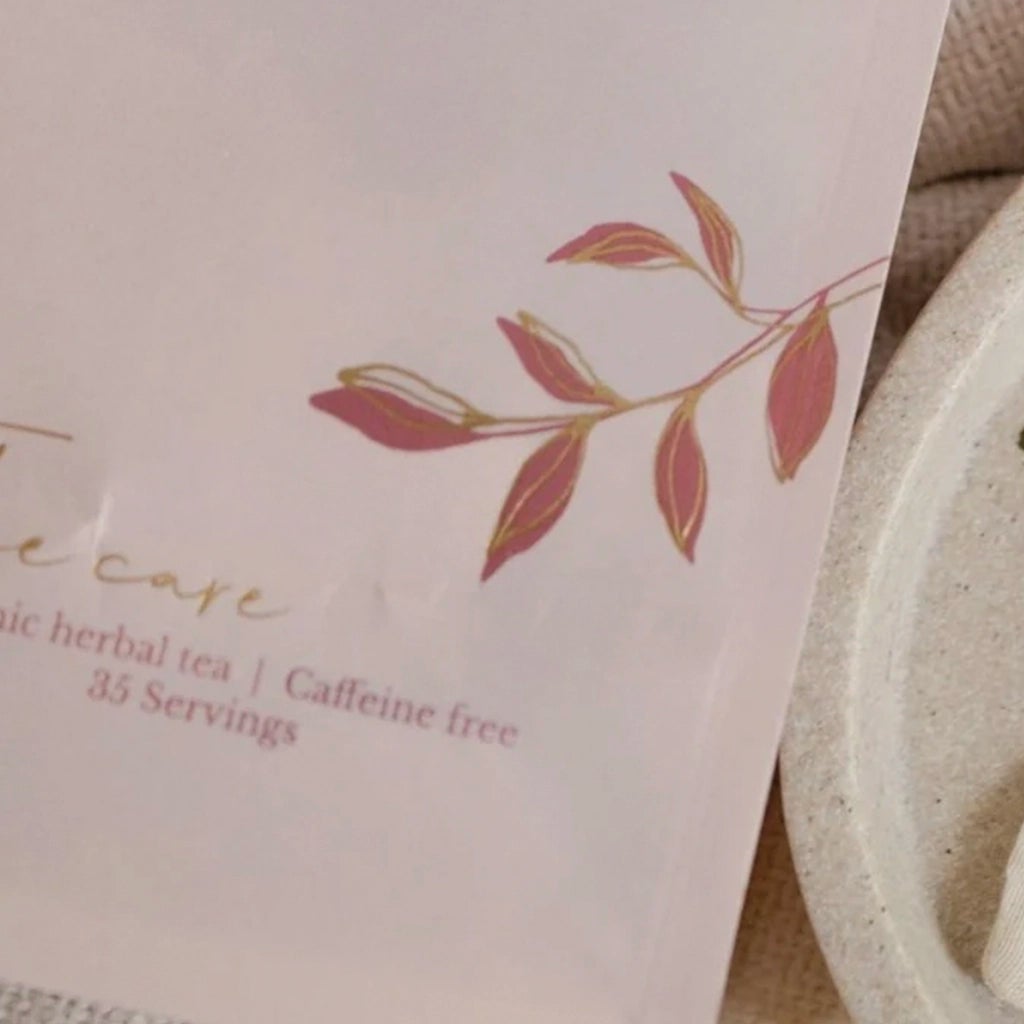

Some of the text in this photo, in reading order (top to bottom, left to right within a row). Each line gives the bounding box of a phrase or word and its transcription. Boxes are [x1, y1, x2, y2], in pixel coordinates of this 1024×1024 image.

[93, 552, 290, 619] care
[50, 610, 169, 668] herbal
[177, 647, 232, 683] tea
[285, 666, 437, 730] Caffeine
[445, 701, 520, 749] free
[87, 667, 301, 751] 35 Servings
